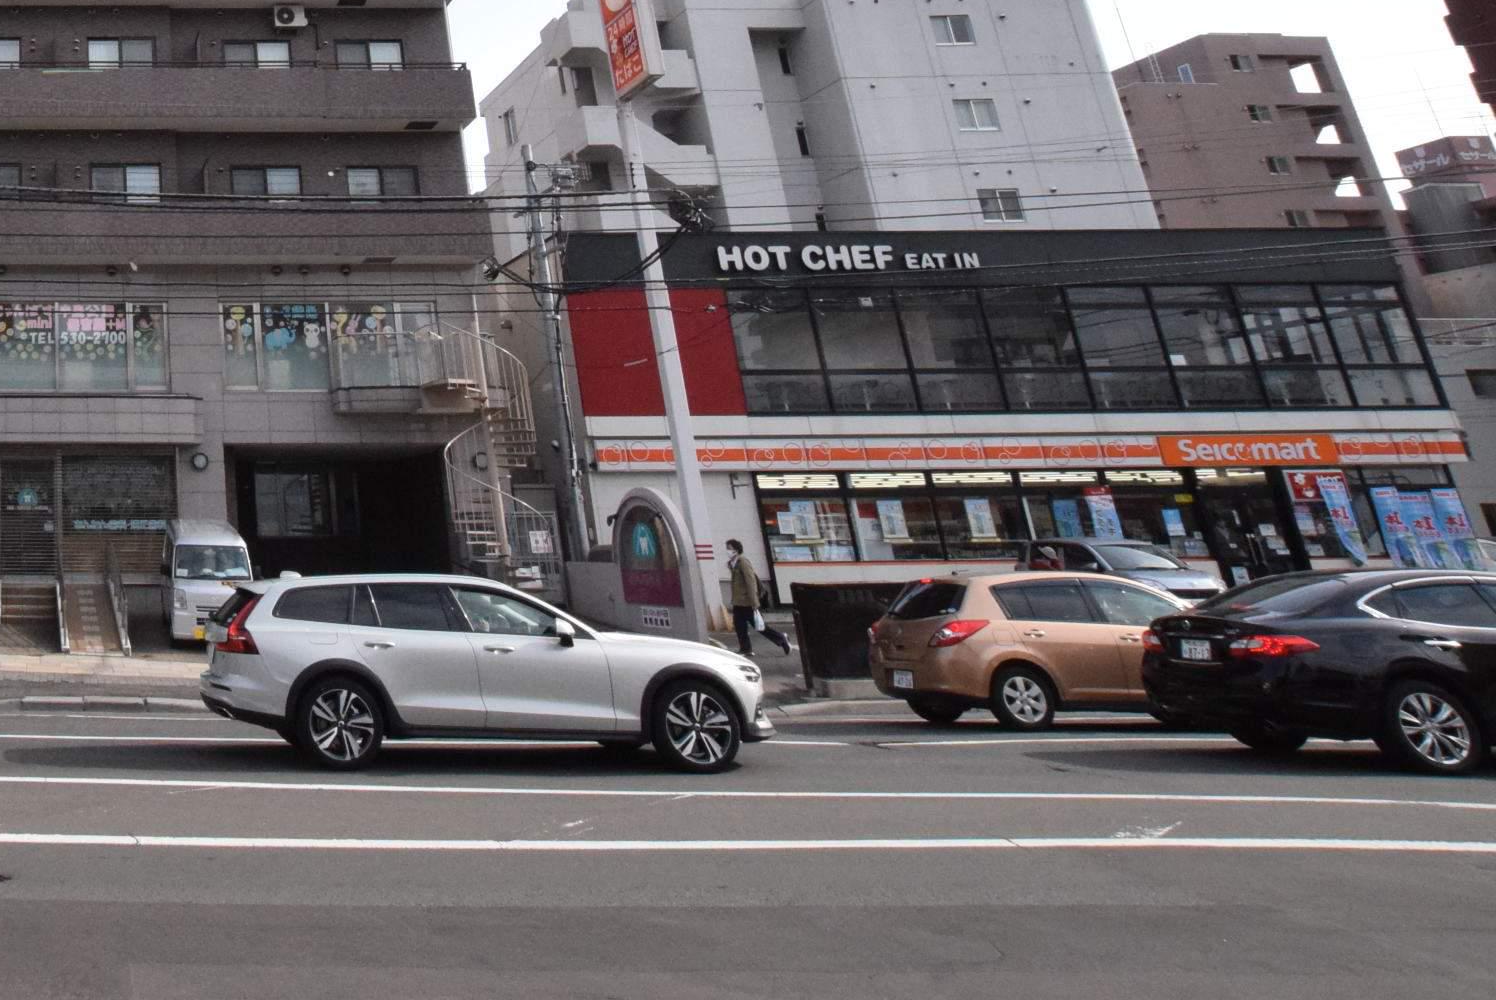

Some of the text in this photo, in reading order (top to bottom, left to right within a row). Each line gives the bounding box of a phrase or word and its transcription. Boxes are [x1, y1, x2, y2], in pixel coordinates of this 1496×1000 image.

[615, 54, 643, 89] たばこ
[717, 245, 980, 271] HOT CHEF EAT IN
[26, 316, 53, 328] mini
[29, 332, 126, 344] TEL 530-2700
[1177, 437, 1321, 462] Seicomart
